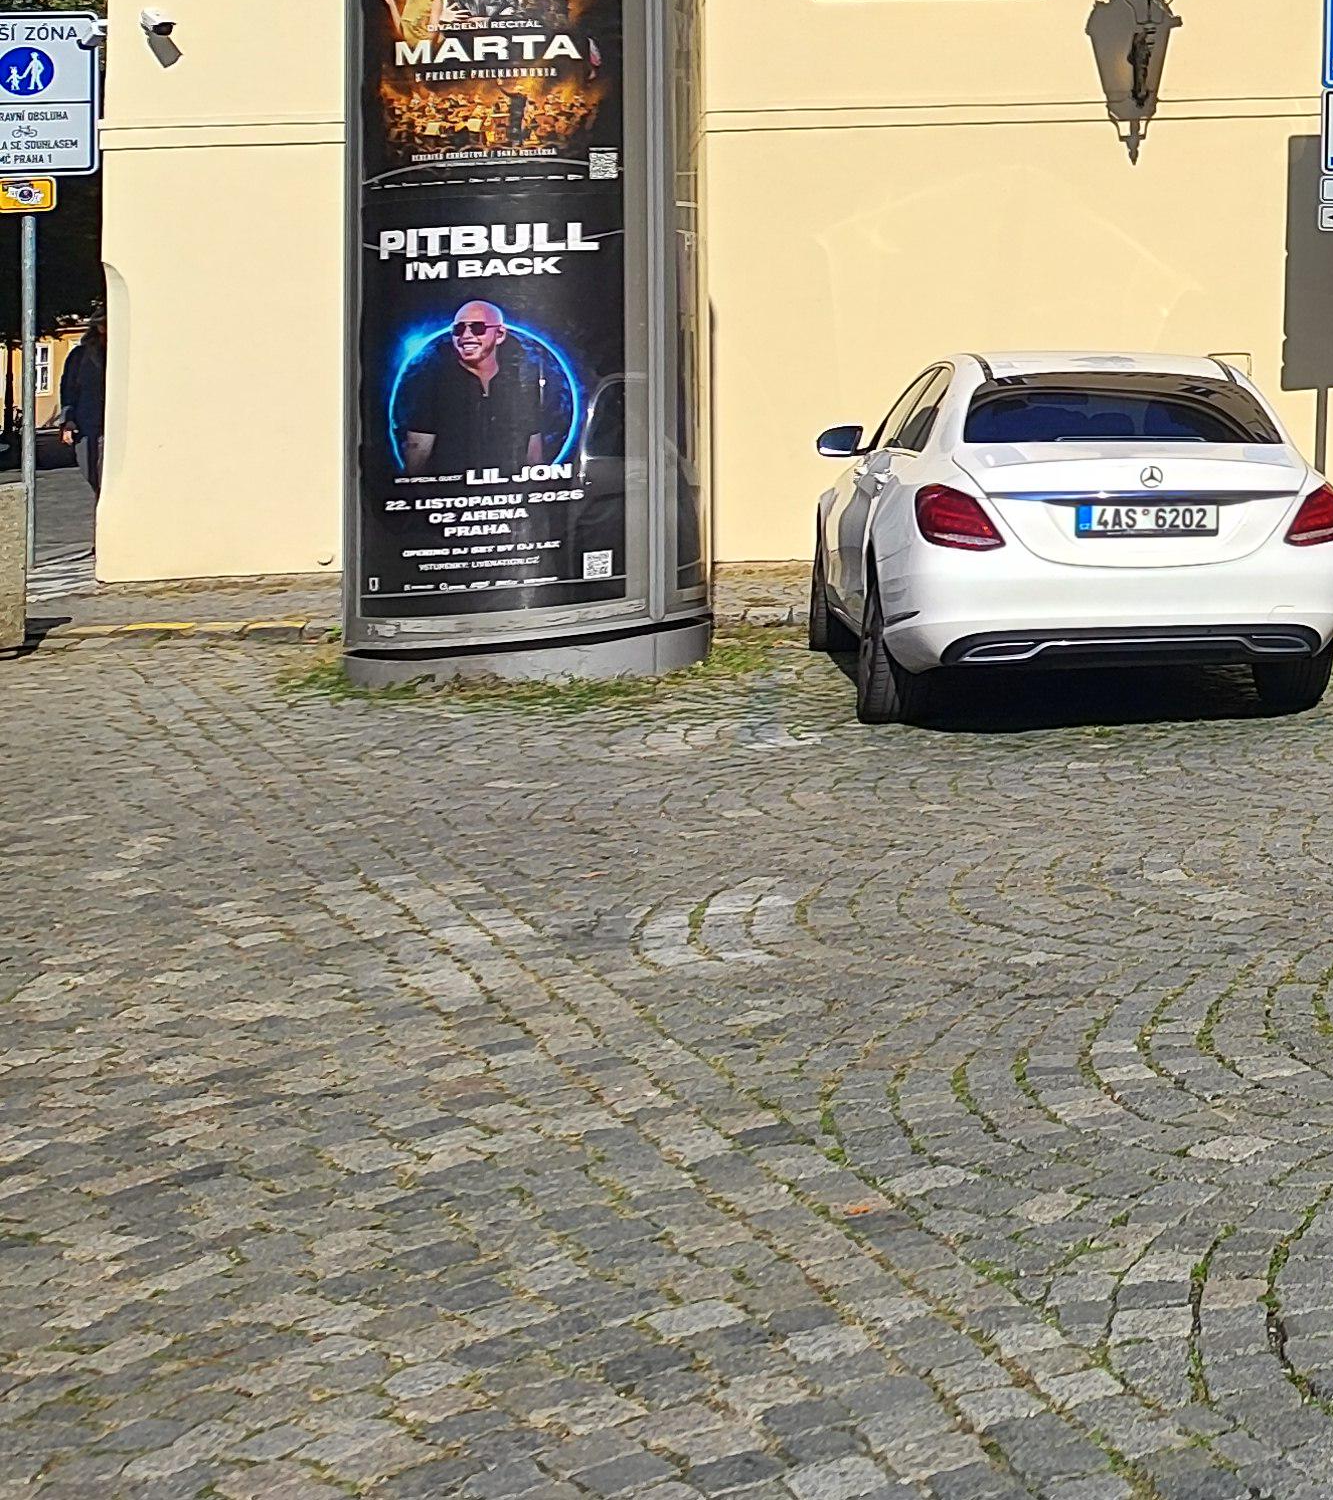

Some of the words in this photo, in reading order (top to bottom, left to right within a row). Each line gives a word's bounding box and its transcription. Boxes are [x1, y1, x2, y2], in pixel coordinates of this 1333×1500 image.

[25, 23, 78, 41] ZÓNA
[490, 20, 543, 29] RECITÁL
[394, 34, 583, 67] MARTA
[28, 111, 69, 121] OBSLUHA
[24, 139, 78, 150] SOUHLASEM
[14, 154, 44, 164] PRAHA
[48, 154, 52, 163] 1
[379, 222, 600, 260] PITBULL
[405, 260, 449, 281] I'M
[457, 256, 563, 279] BACK
[465, 468, 509, 485] LIL
[511, 463, 573, 483] JON
[384, 500, 411, 511] 22.
[415, 492, 524, 510] LISTOPADU
[527, 489, 585, 504] 2026
[460, 507, 529, 522] ARENA
[1097, 507, 1137, 529] 4AS
[1154, 508, 1207, 529] 6202
[443, 523, 512, 538] PRAHA
